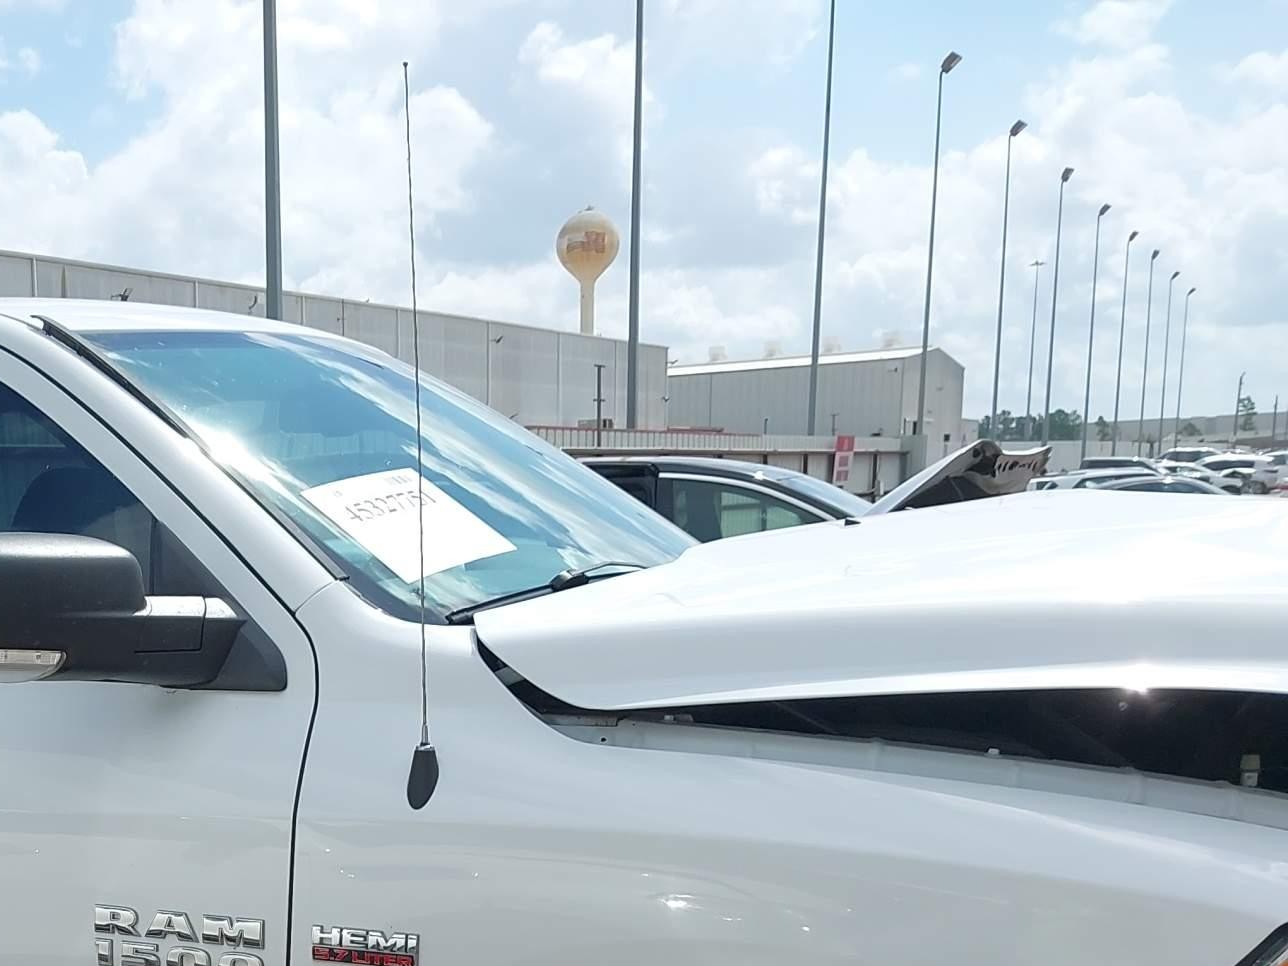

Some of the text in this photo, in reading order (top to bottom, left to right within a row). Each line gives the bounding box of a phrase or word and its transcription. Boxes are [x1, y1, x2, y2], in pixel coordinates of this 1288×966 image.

[94, 904, 265, 950] RAM
[312, 925, 420, 953] HEMI
[313, 947, 349, 961] 5.7
